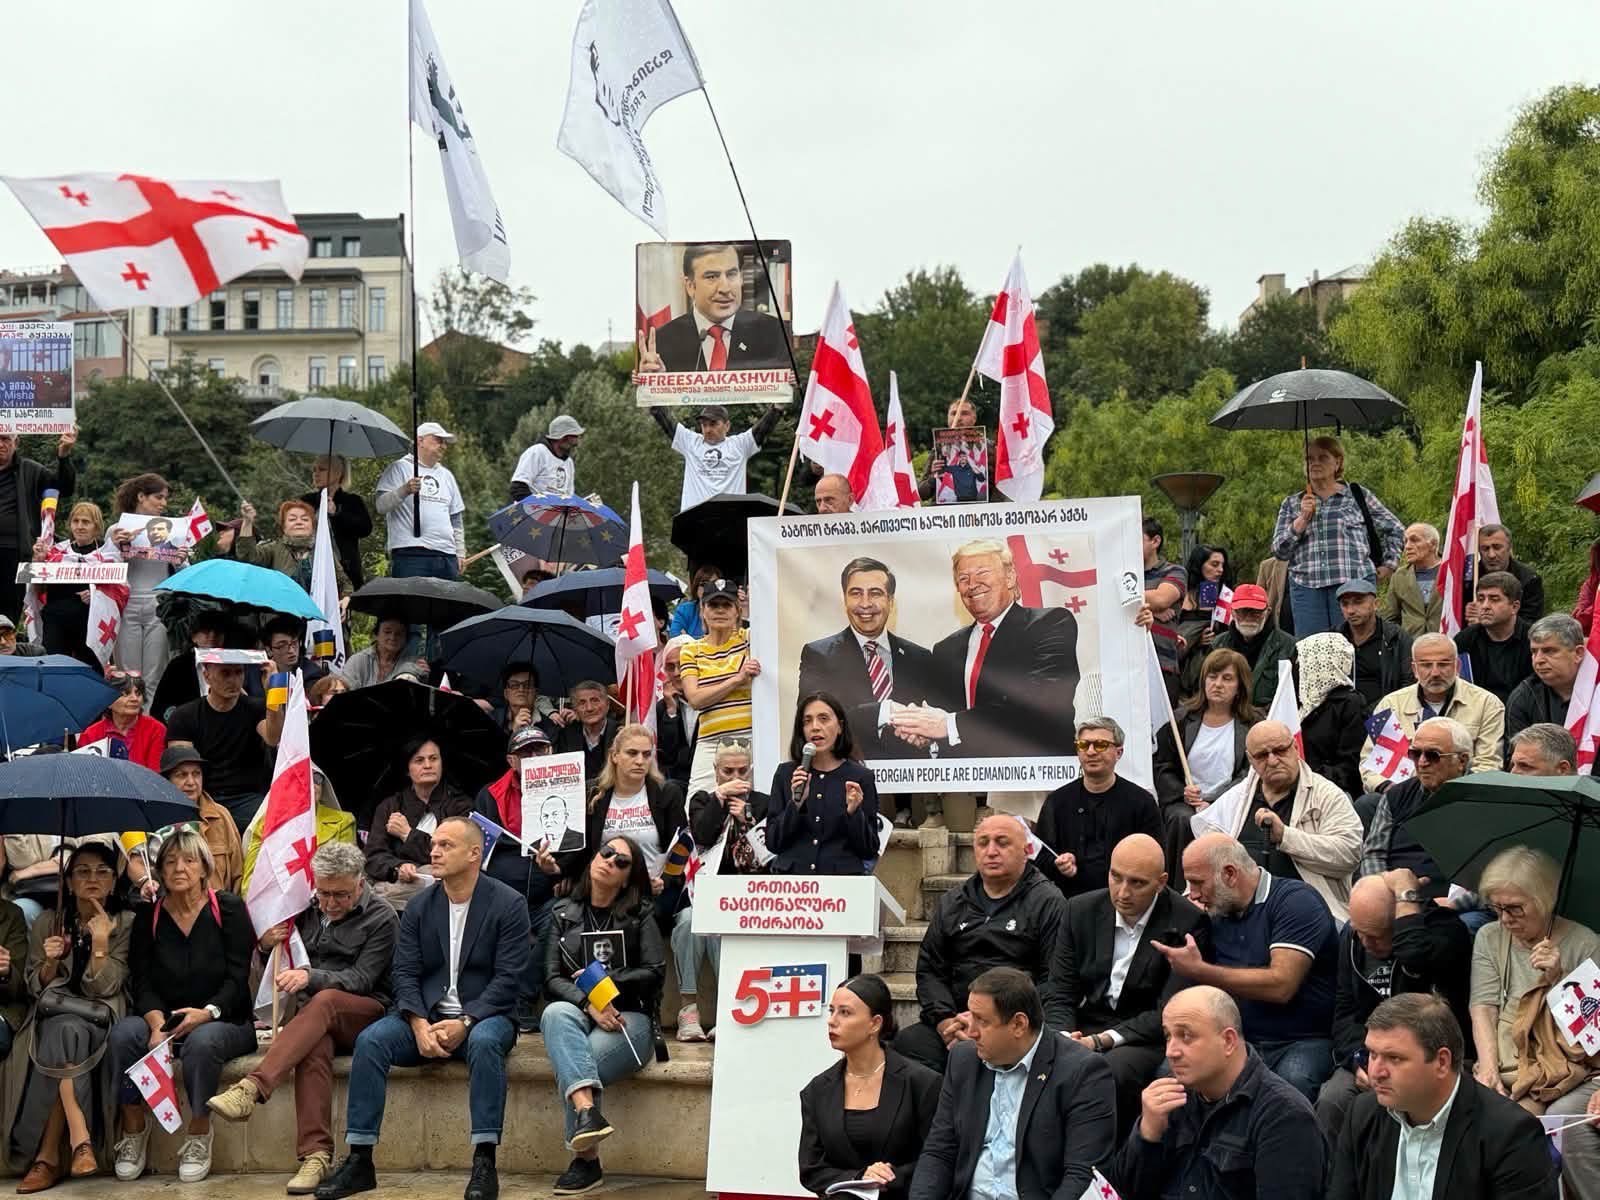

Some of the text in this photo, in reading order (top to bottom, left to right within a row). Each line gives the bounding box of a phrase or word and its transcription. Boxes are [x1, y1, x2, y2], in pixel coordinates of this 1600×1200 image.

[638, 372, 789, 386] #FREESAAKASHVILI
[781, 522, 822, 538] ბატონო
[860, 517, 918, 534] ქართველი
[919, 514, 956, 530] ხალხი
[958, 510, 1003, 529] ითხოვს
[1004, 508, 1058, 526] მეგობარ
[1060, 506, 1088, 523] აქტს
[873, 767, 915, 783] EORGIAN
[916, 766, 951, 782] PEOPLE
[952, 766, 971, 781] ARE
[972, 765, 1028, 781] DEMANDING
[1029, 765, 1036, 780] A
[747, 880, 820, 895] ერთიანი
[719, 896, 847, 913] ნაციონალური
[739, 915, 824, 930] მოძრაობა
[731, 969, 772, 1025] 5
